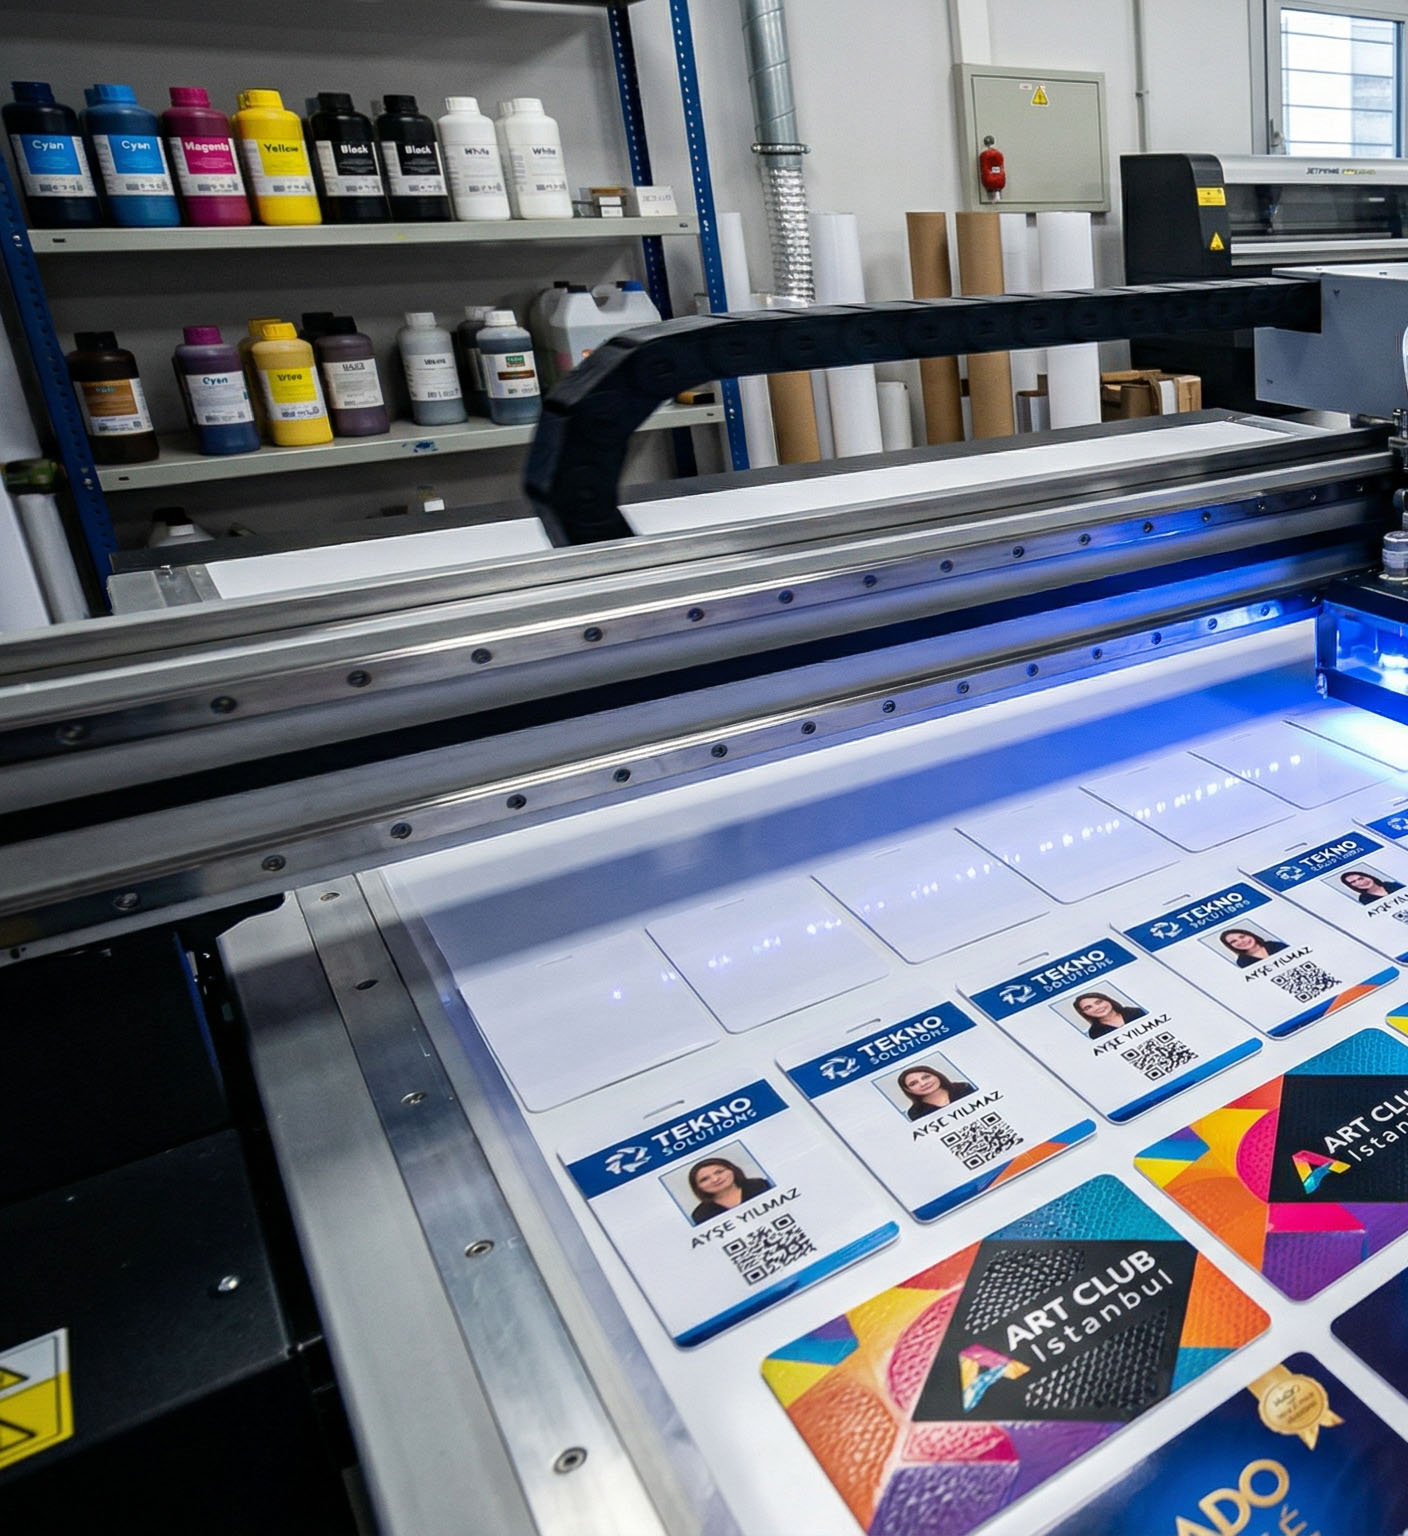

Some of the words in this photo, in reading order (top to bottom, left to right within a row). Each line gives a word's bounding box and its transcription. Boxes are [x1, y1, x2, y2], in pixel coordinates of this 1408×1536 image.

[1299, 840, 1358, 867] TEKNO
[1176, 892, 1243, 922] TEKNO
[1030, 950, 1106, 985] TEKNO
[857, 1015, 943, 1058] TEKNO
[1123, 1013, 1172, 1040] YILMAZ
[651, 1097, 752, 1148] TEKNO
[949, 1089, 1004, 1122] YILMAZ
[660, 1108, 758, 1157] SOLUTIONS
[1322, 1114, 1374, 1155] ART
[690, 1218, 735, 1250] AYŞE
[736, 1187, 802, 1225] YILMAZ
[1004, 1297, 1074, 1352] ART
[1071, 1248, 1157, 1308] CLUB
[1029, 1269, 1175, 1364] Istanbul
